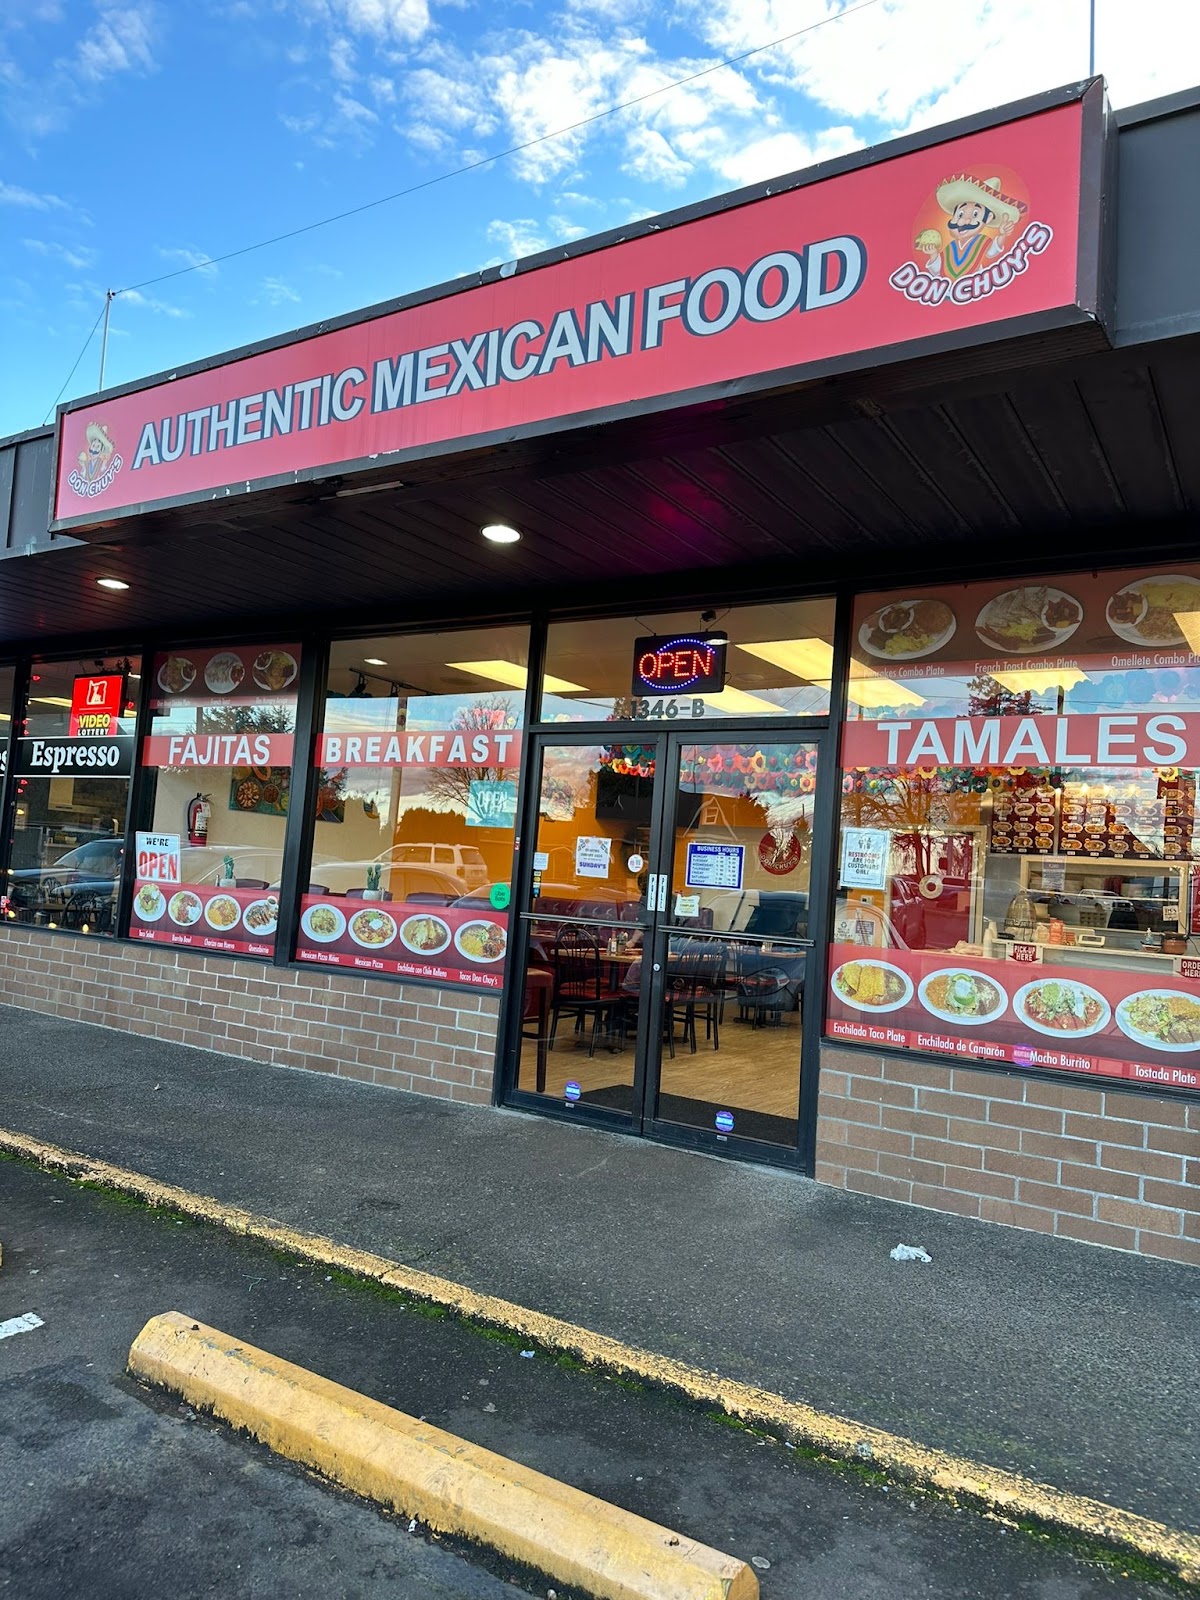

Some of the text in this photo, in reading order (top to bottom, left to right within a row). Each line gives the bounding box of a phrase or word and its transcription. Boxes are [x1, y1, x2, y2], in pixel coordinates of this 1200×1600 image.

[892, 223, 1051, 304] DON CHUY'S
[131, 235, 867, 471] AUTHENTIC MEXICAN FOOD
[69, 455, 122, 497] DON CHUY'S
[639, 650, 711, 678] OPEN
[975, 657, 1078, 673] French Toast Combo Plate
[1111, 654, 1151, 667] Omellete
[1154, 652, 1185, 665] Combo
[899, 666, 924, 677] Combo
[926, 665, 945, 676] Plate
[631, 698, 705, 719] 1346-B
[79, 713, 111, 728] VIDEO
[77, 728, 109, 736] LOTTERY
[877, 714, 1188, 766] TAMALES
[30, 741, 120, 773] Espresso
[168, 735, 271, 766] FAJITAS
[325, 734, 513, 764] BREAKFAST
[146, 837, 170, 847] WE'RE
[721, 846, 740, 854] HOURS
[139, 850, 178, 880] OPEN
[1014, 945, 1036, 955] PICK-UP
[1016, 953, 1033, 962] HERE
[459, 971, 498, 987] Tacos Don Chuy's
[833, 1022, 906, 1043] Enchilada Taco Plate
[917, 1034, 954, 1050] Enchilada
[956, 1039, 967, 1052] de
[968, 1042, 1005, 1058] Camarón
[1029, 1050, 1058, 1065] Macho
[1060, 1054, 1091, 1070] Burrito
[1134, 1064, 1197, 1085] Tostada Plate
